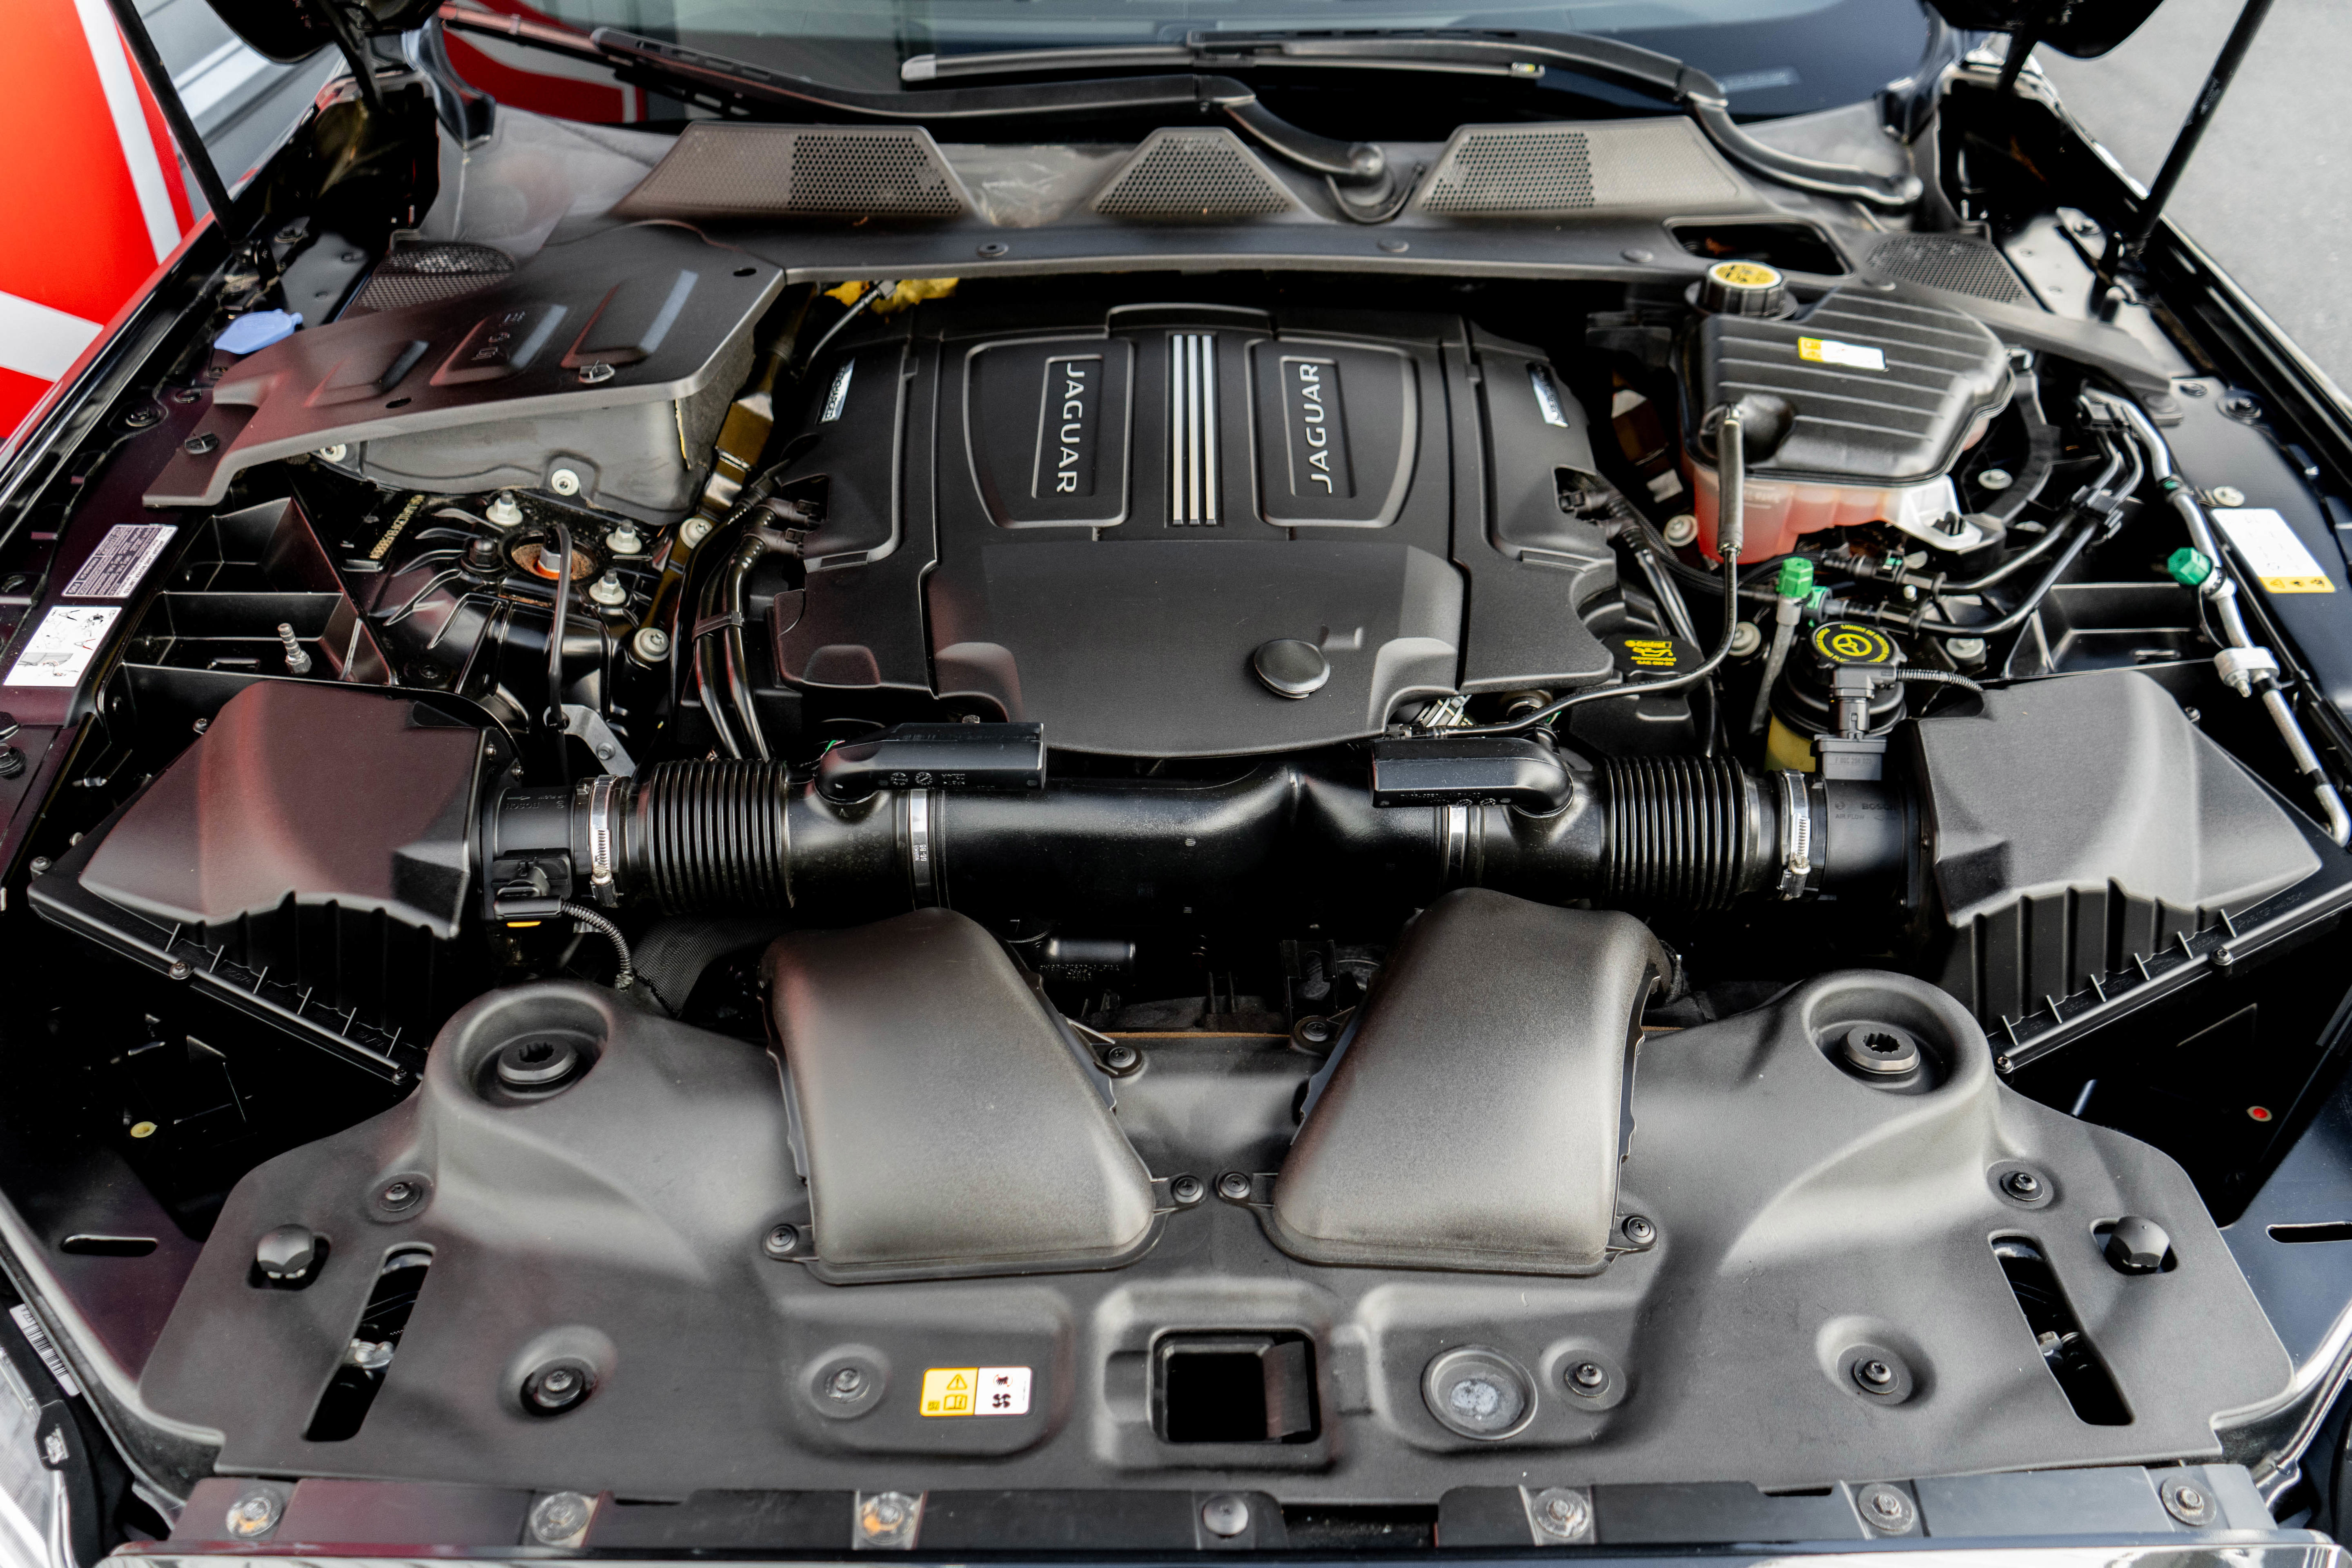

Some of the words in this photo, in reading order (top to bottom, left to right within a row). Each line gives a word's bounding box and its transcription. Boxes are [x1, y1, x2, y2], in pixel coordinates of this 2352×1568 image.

[1056, 362, 1085, 493] JAGUAR
[1299, 363, 1333, 494] JAGUAR
[1862, 803, 1896, 811] BOSCH
